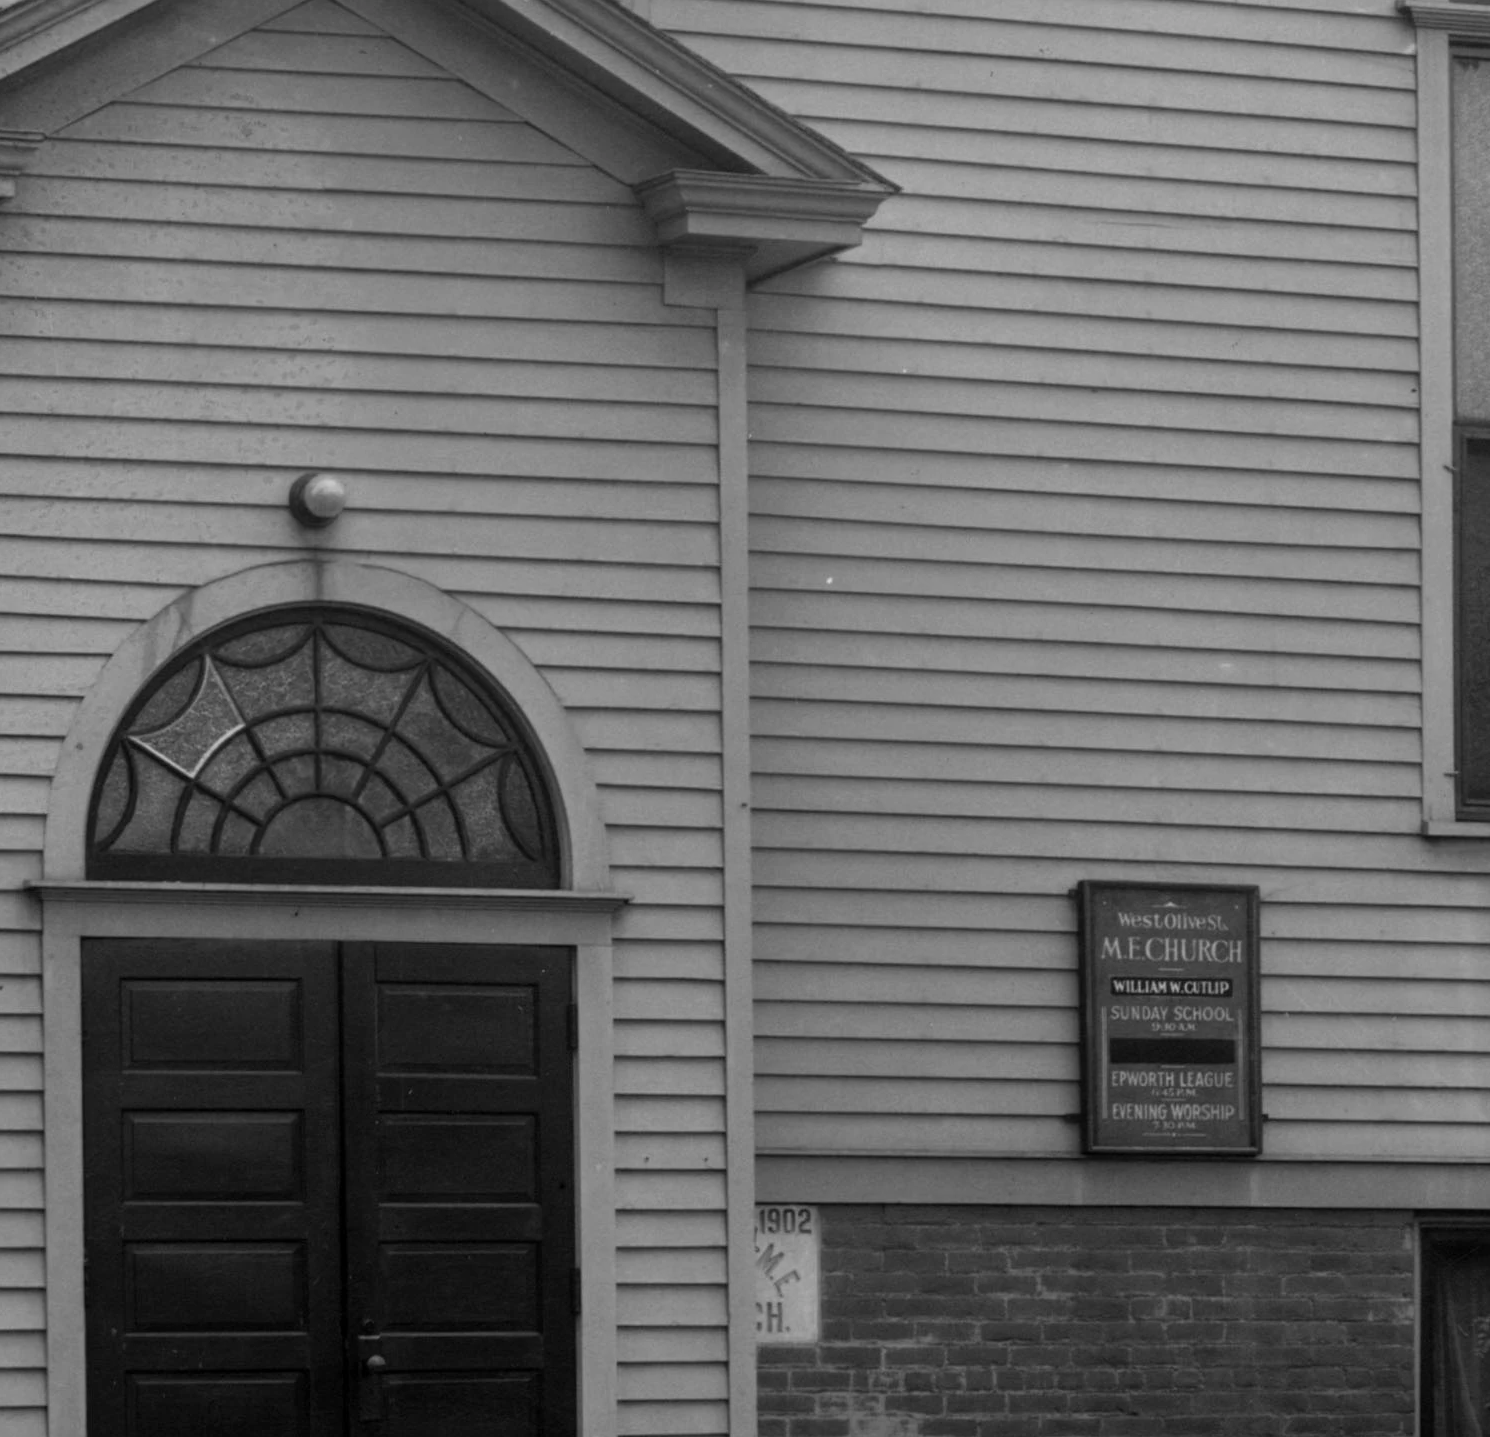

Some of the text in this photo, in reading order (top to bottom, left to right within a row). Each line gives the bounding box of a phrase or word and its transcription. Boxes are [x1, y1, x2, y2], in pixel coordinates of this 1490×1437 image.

[1118, 912, 1164, 929] West
[1163, 912, 1207, 930] Olive
[1100, 936, 1244, 964] M.E. CHURCH
[1112, 979, 1230, 995] WILLIAM W. CUTLIP
[1110, 1005, 1235, 1022] SUNDAY SCHOOL
[1111, 1070, 1235, 1088] EPWORTH LEAGUE
[1112, 1102, 1235, 1121] EVENING WORSHIP
[759, 1208, 812, 1235] 1902
